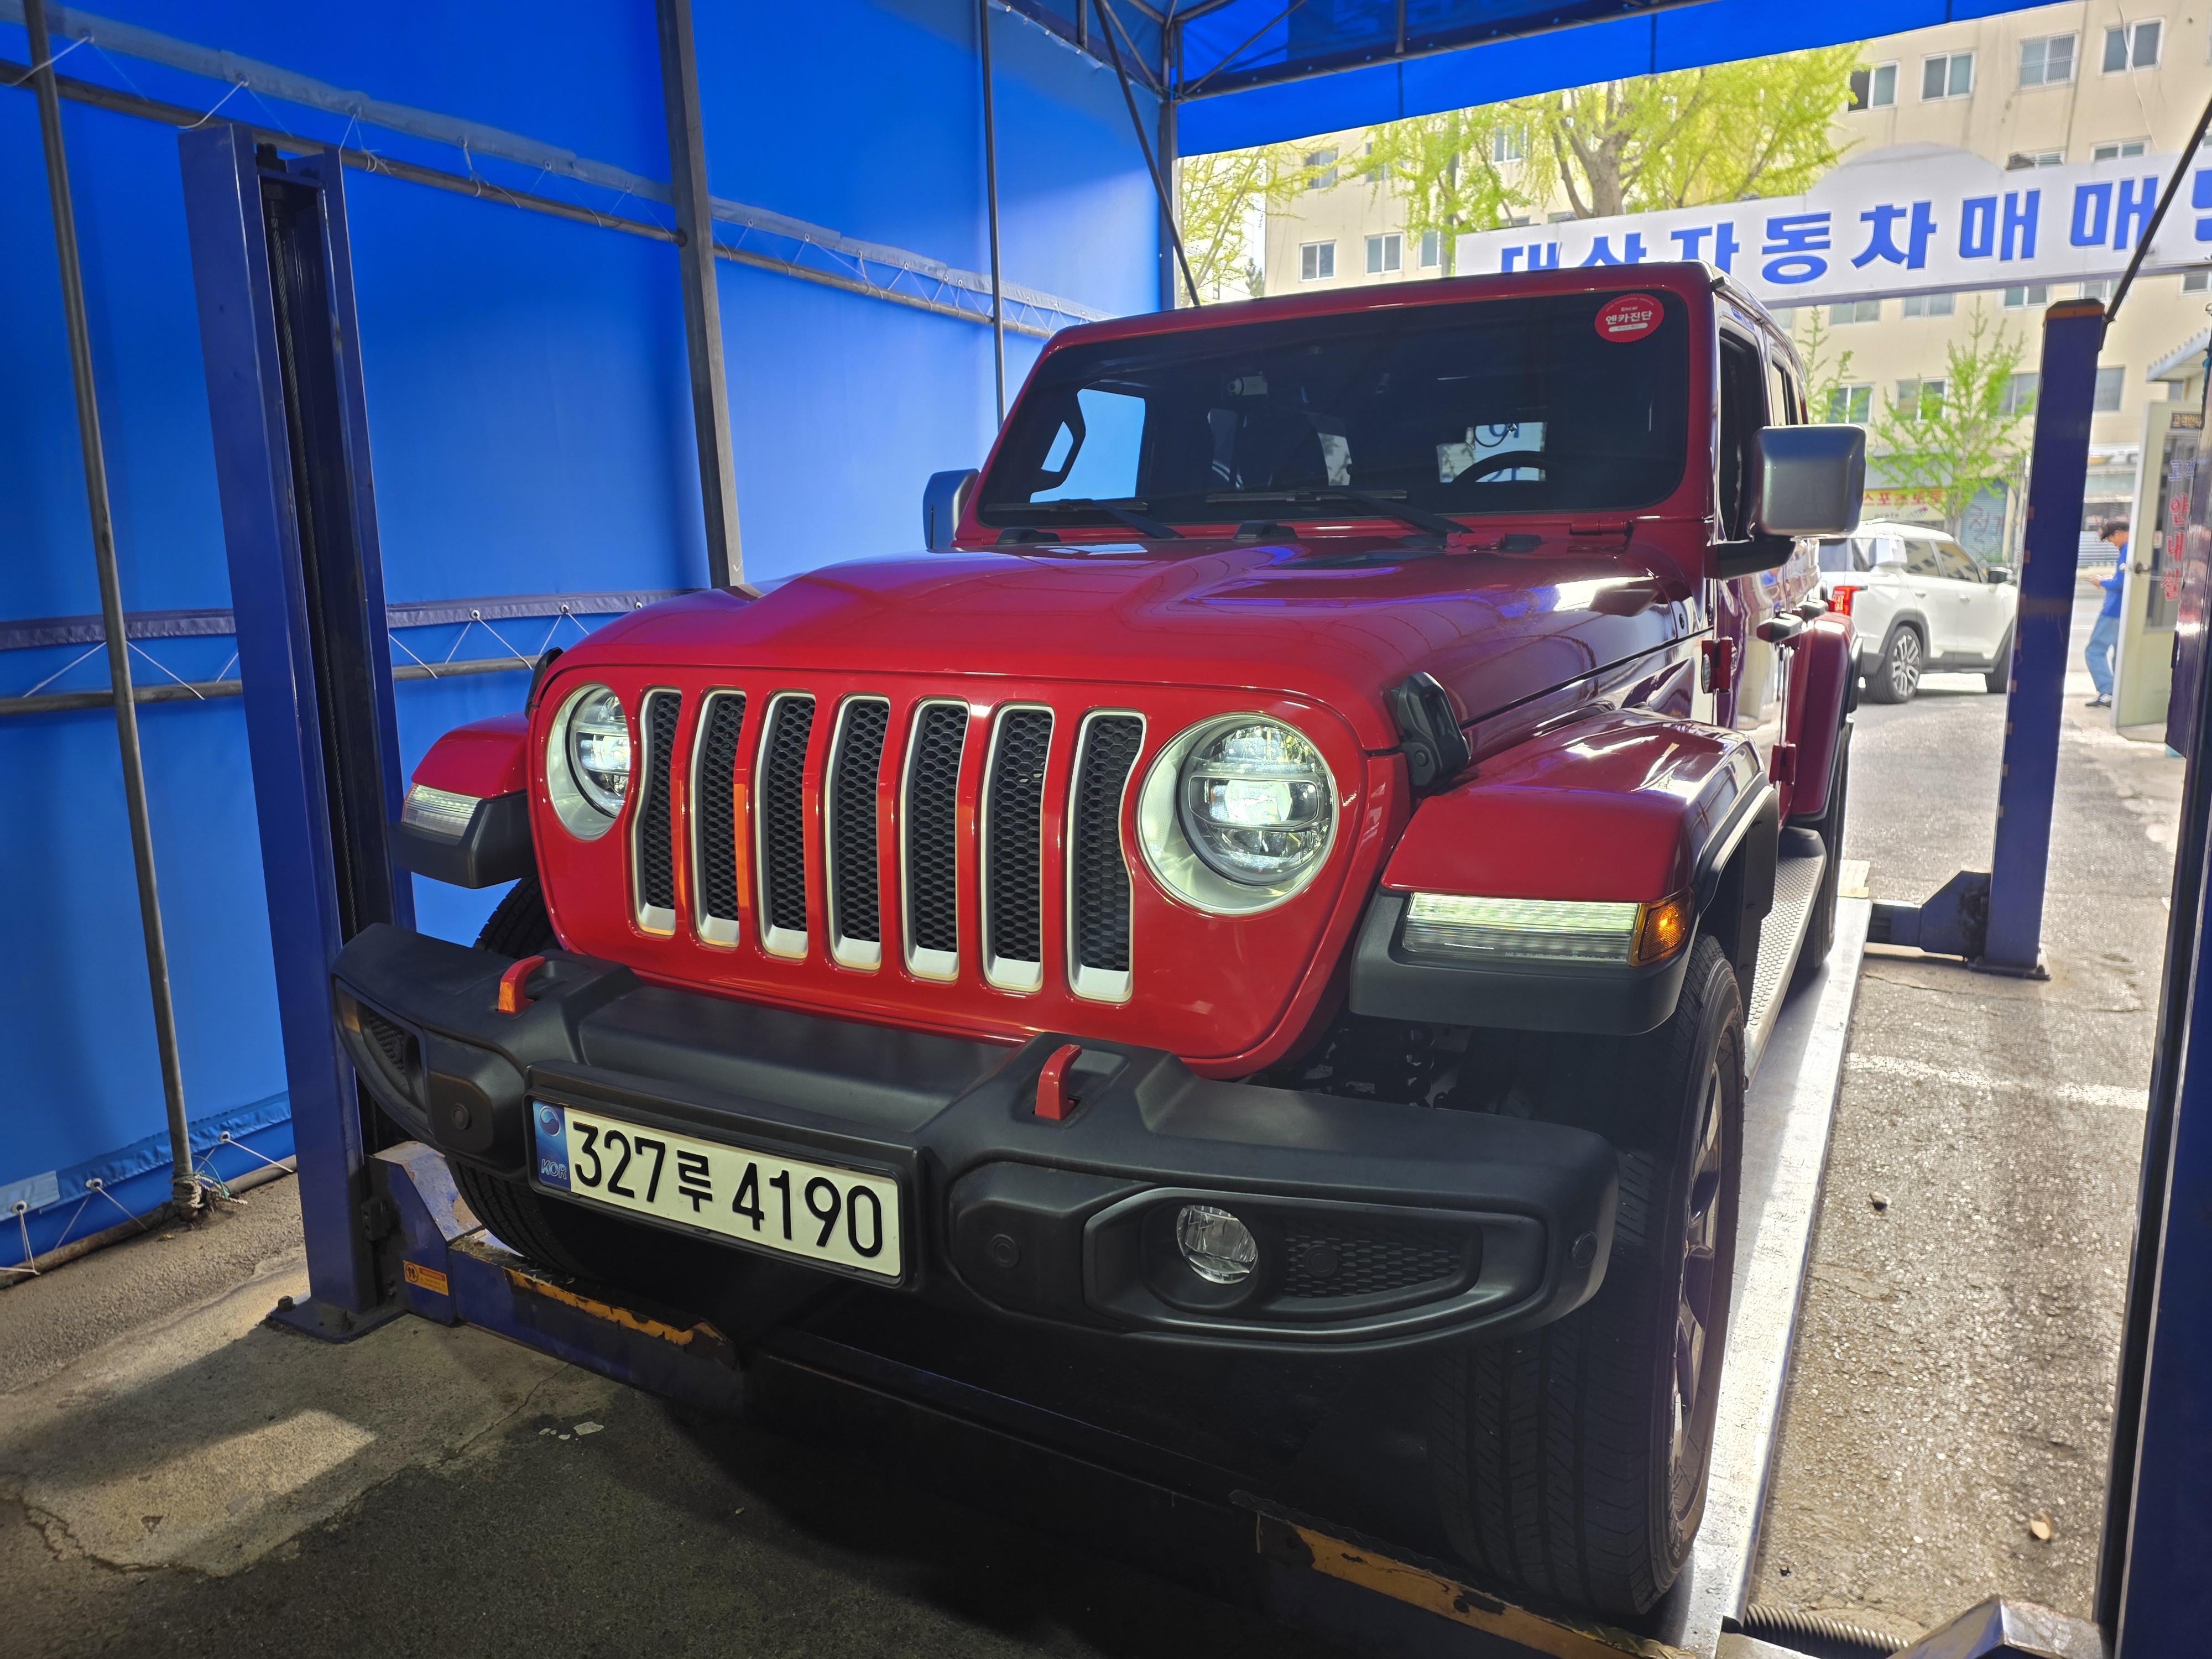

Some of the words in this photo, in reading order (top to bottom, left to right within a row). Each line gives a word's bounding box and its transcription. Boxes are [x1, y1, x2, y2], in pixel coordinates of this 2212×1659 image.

[1605, 310, 1653, 325] 엔카진단
[541, 1159, 567, 1180] KOR
[732, 1162, 883, 1258] 4190
